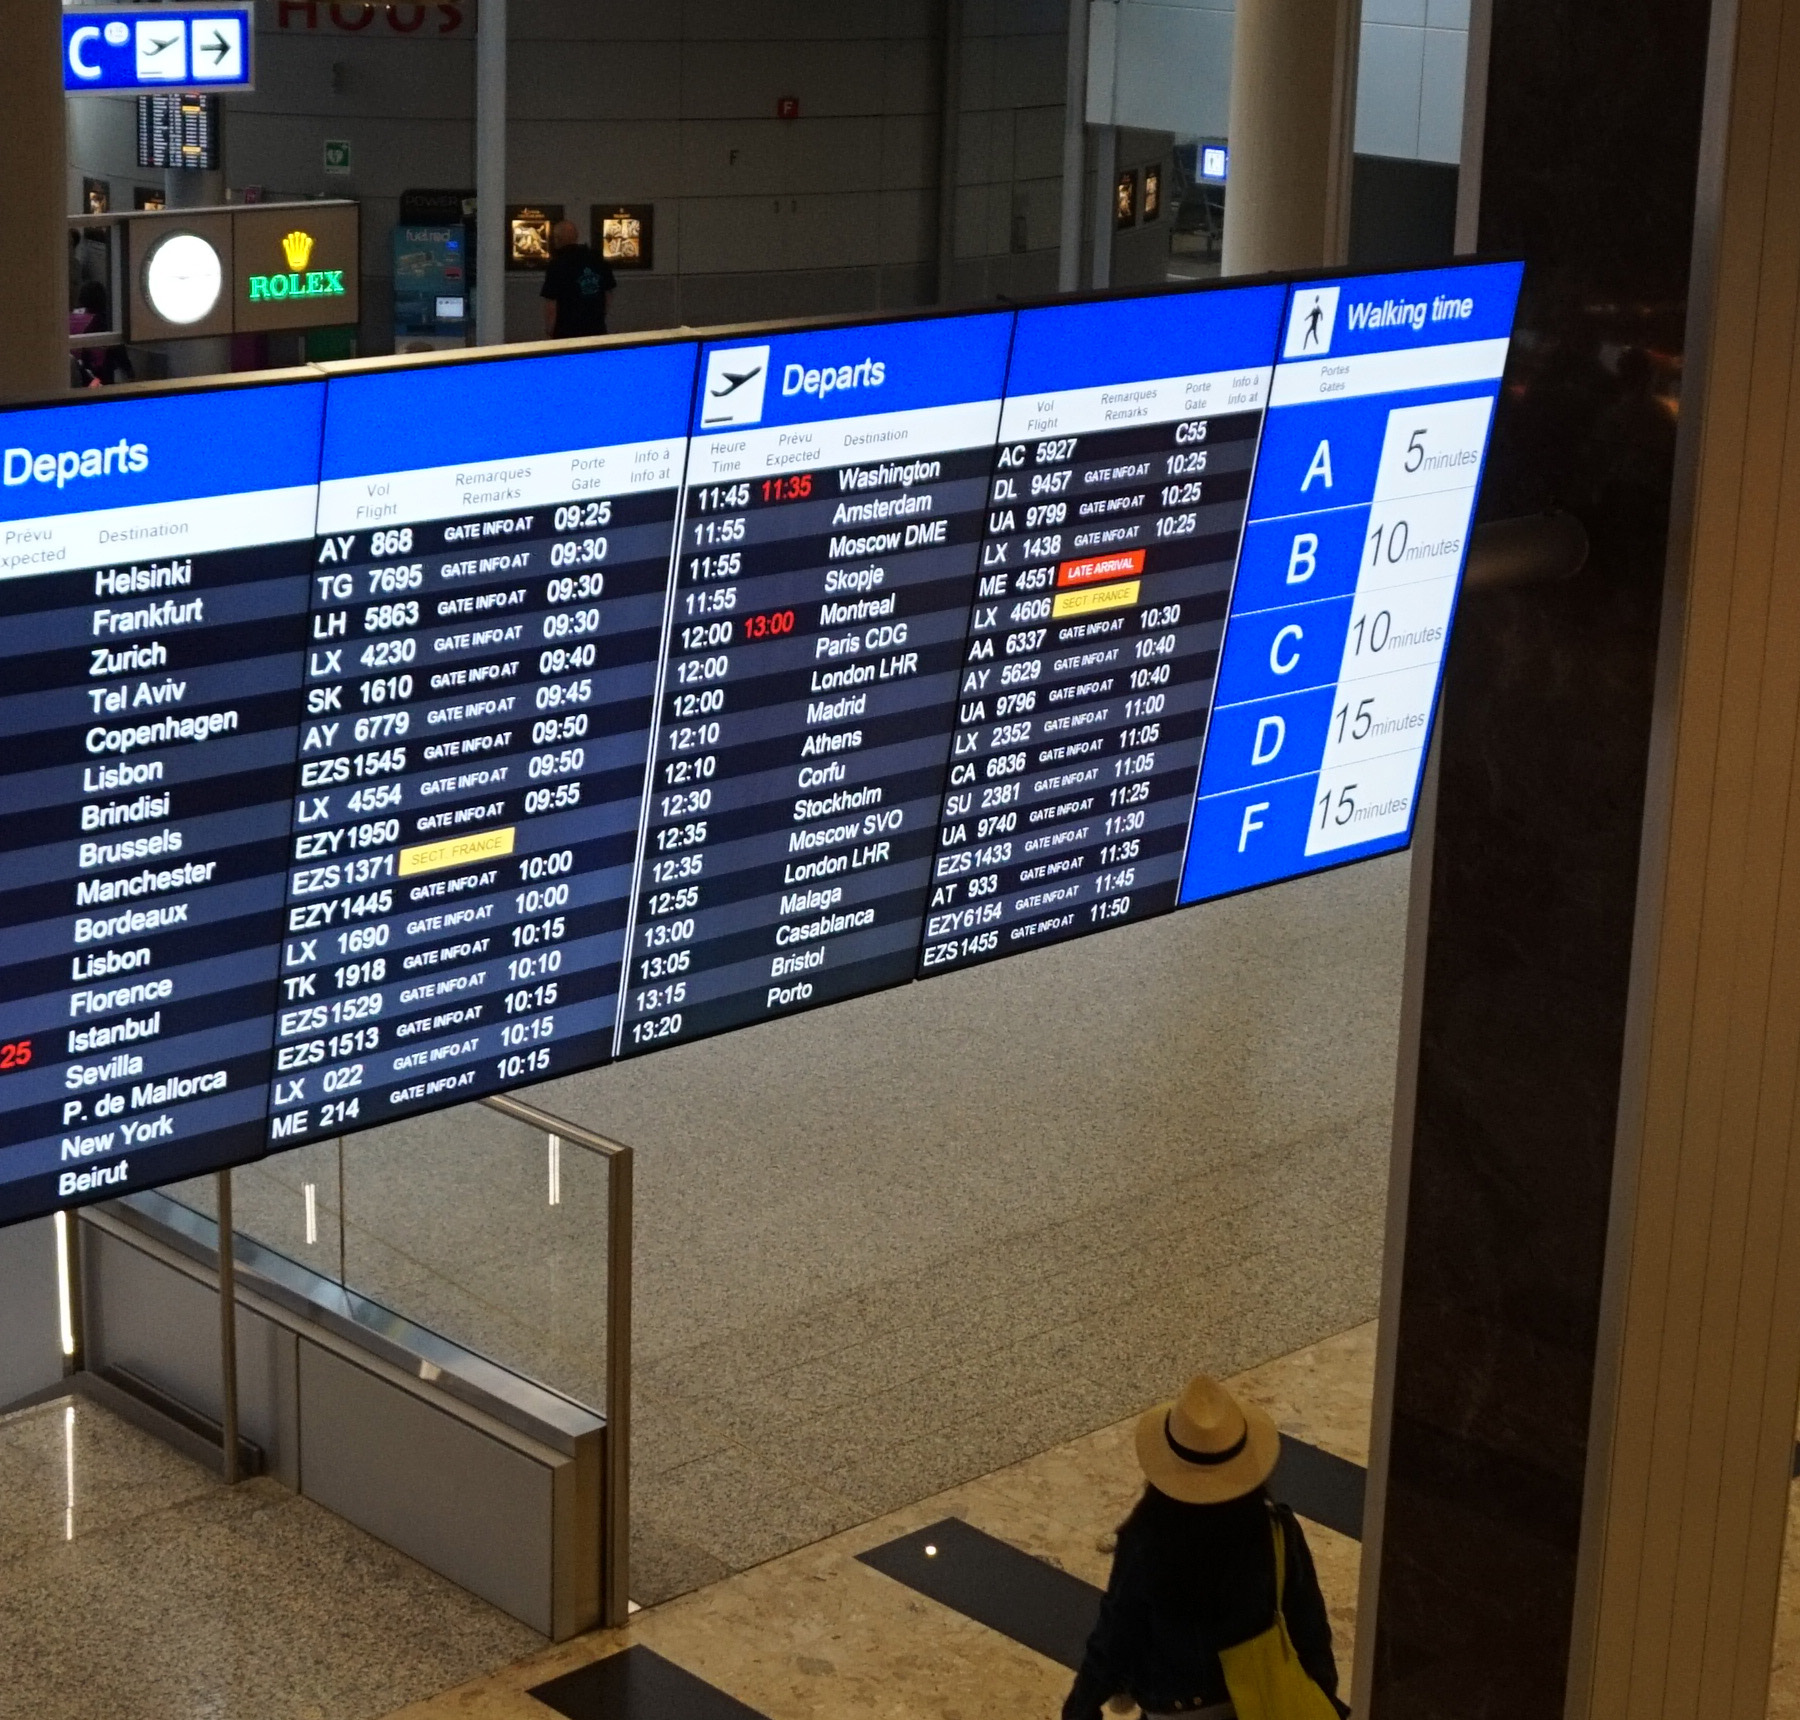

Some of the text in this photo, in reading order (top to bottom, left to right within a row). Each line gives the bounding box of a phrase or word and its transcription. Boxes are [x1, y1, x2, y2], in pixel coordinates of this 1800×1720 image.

[69, 26, 102, 79] C
[249, 270, 345, 302] ROLEX
[1349, 295, 1473, 330] Walking time
[782, 358, 885, 398] Departs
[1320, 365, 1350, 377] Portes
[1185, 382, 1212, 394] Porte
[1319, 382, 1346, 393] Gates
[1027, 417, 1058, 433] Flight
[1104, 406, 1148, 421] Remarks
[778, 433, 813, 446] Prévu
[843, 429, 909, 447] Destination
[1176, 421, 1207, 443] C55
[4, 439, 148, 488] Departs
[998, 439, 1077, 468] AC 5927
[1167, 451, 1207, 474] 10:25
[1301, 440, 1332, 491] A
[455, 467, 532, 486] Remarques
[571, 478, 601, 491] Gate
[763, 475, 811, 500] 11:35
[839, 460, 940, 490] Washington
[994, 470, 1072, 500] DL 9457
[1085, 463, 1150, 483] GATE INFO AT
[367, 482, 390, 498] Vol
[699, 483, 750, 510] 11:45
[444, 516, 533, 541] GATE INFO AT
[555, 501, 611, 530] 09:25
[98, 522, 189, 545] Destination
[319, 528, 412, 563] AY 868
[829, 520, 947, 558] Moscow DME
[1068, 558, 1133, 578] LATE ARRIVAL
[1287, 533, 1318, 584] B
[96, 559, 191, 595] Helsinki
[979, 566, 1054, 596] ME 4551
[820, 593, 895, 625] Montreal
[745, 611, 794, 638] 13:00
[1270, 625, 1303, 674] C
[88, 678, 186, 713] Tel Aviv
[532, 714, 588, 744] 09:50
[1252, 716, 1285, 765] D
[302, 747, 406, 787] EZS 1545
[1239, 802, 1269, 852] F
[411, 836, 502, 866] SECT. FRANCE
[77, 862, 216, 905] Manchester
[1091, 896, 1130, 921] 11:50
[776, 909, 874, 945] Casablanca
[924, 931, 998, 966] EZS 1455
[69, 1011, 160, 1053] Istanbul
[633, 1014, 682, 1043] 13:20
[498, 1048, 550, 1079] 10:15
[63, 1071, 227, 1125] P. de Mallorca
[272, 1098, 359, 1139] ME 214
[59, 1160, 128, 1195] Beirut
